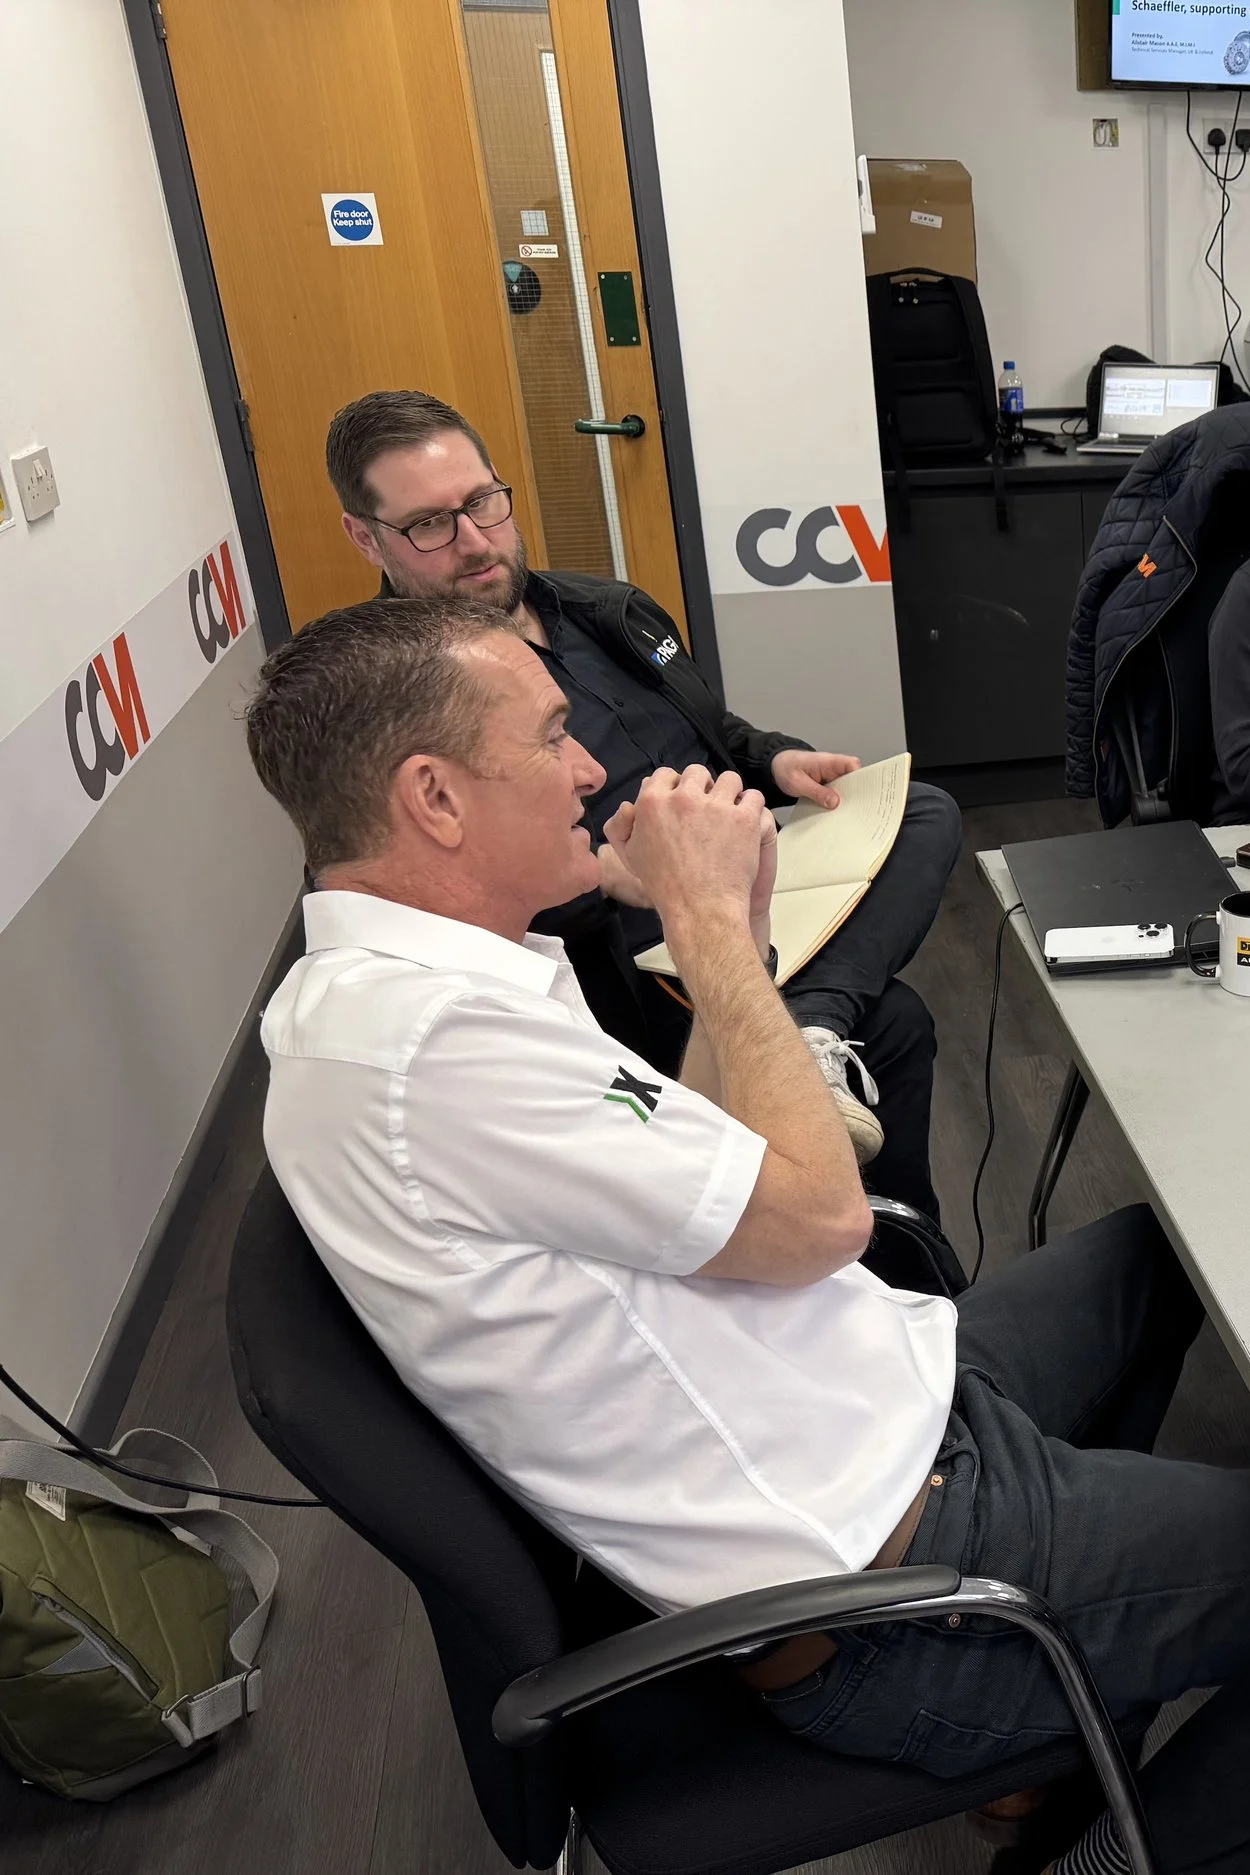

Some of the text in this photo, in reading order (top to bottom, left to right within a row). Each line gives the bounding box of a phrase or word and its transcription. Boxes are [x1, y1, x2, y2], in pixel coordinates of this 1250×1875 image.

[1132, 0, 1187, 14] Schaeffler,
[1190, 4, 1246, 17] supporting
[334, 210, 368, 218] Fire door
[333, 218, 372, 227] Keep shut
